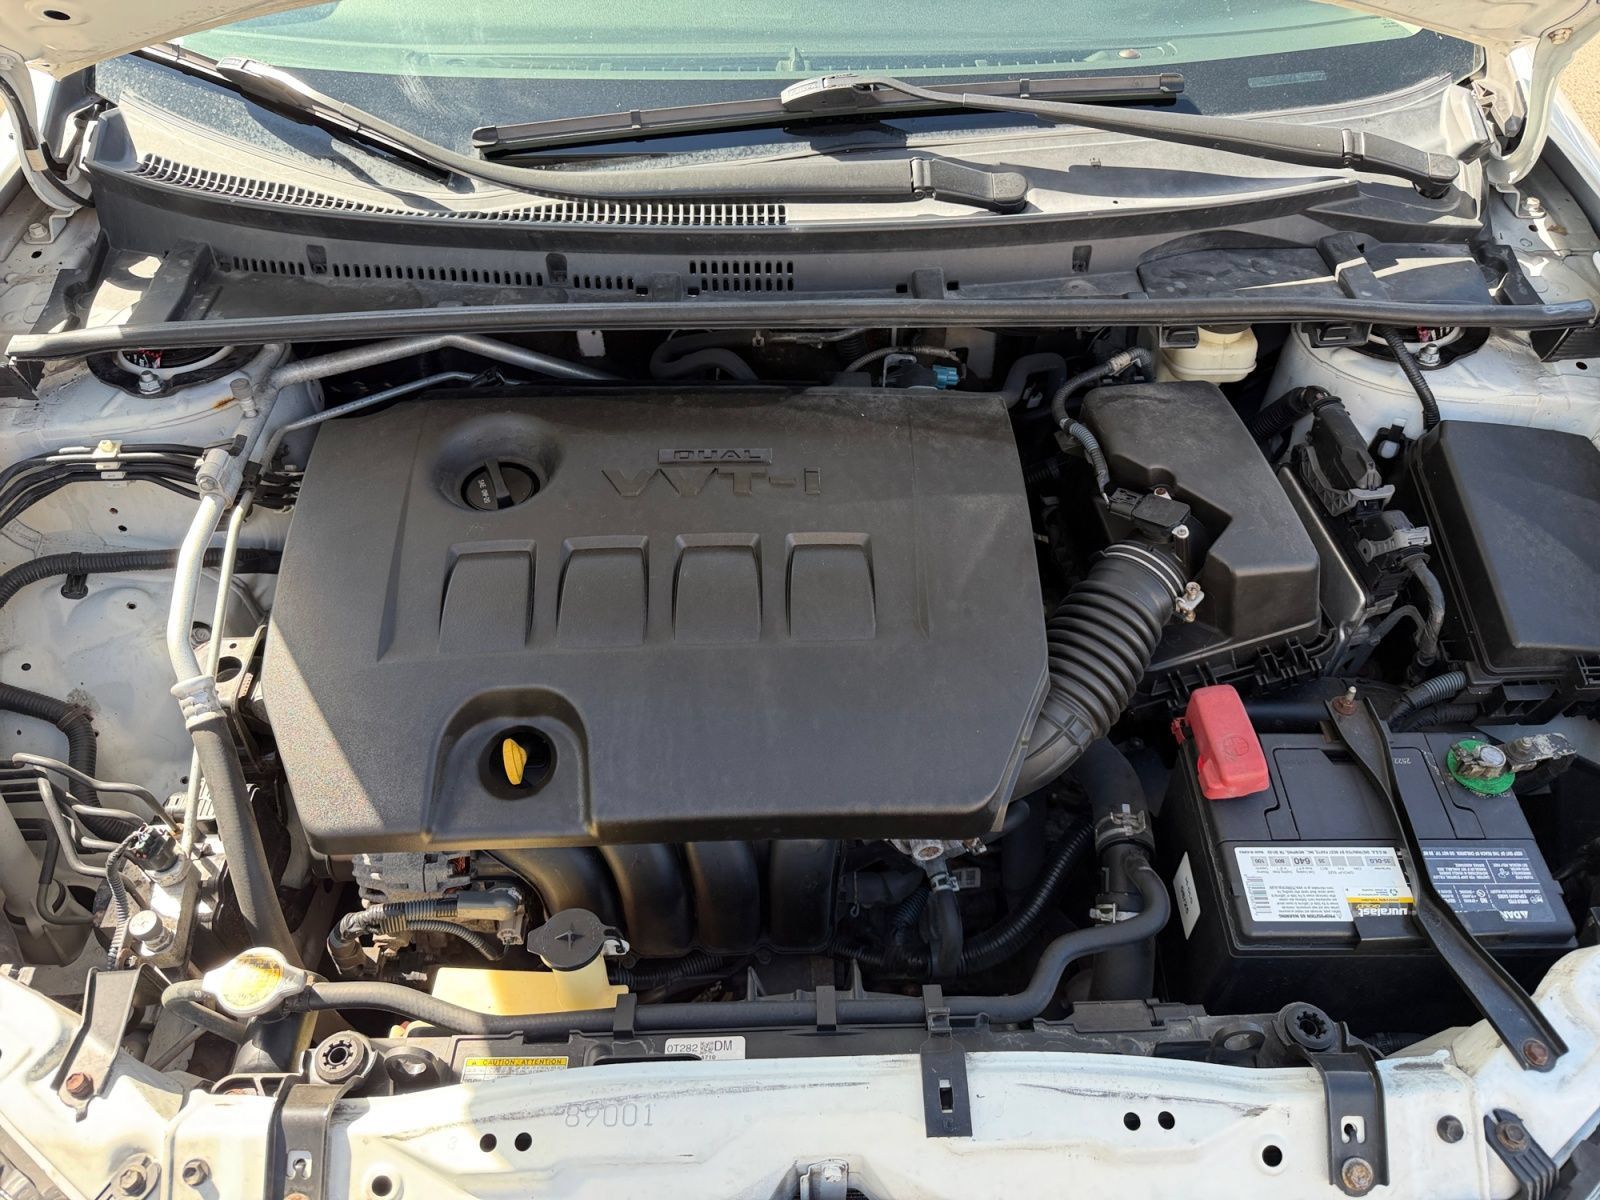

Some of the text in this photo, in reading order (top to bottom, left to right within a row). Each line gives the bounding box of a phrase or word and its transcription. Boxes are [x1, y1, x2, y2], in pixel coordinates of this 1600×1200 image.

[673, 449, 762, 460] DUAL
[714, 1040, 733, 1052] DM
[564, 1102, 653, 1128] 89001
